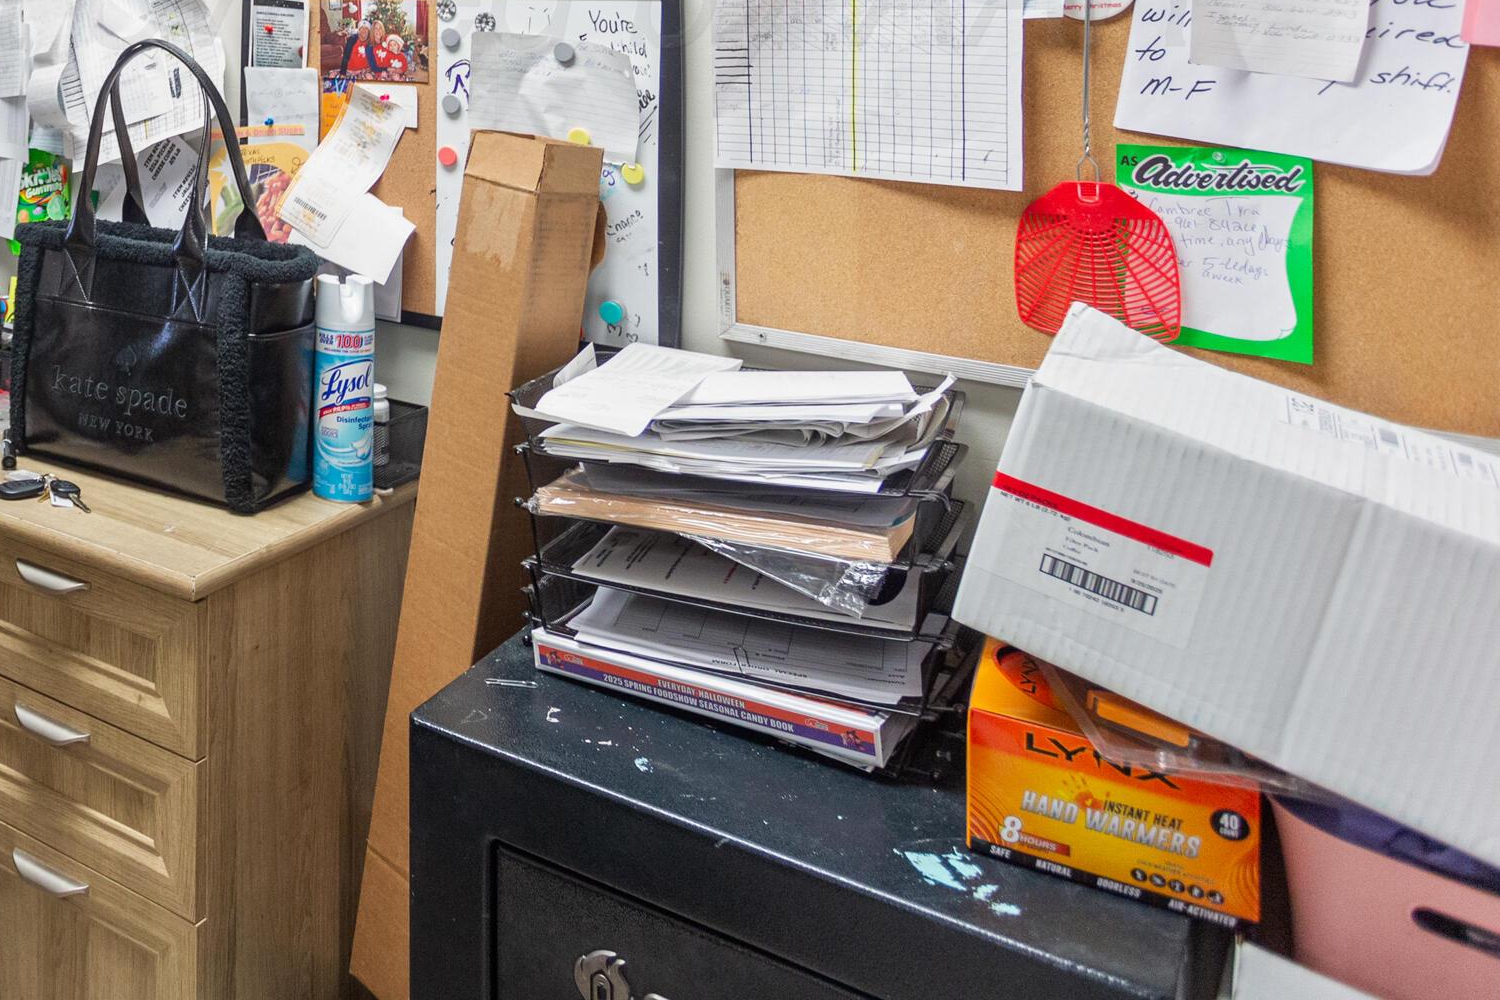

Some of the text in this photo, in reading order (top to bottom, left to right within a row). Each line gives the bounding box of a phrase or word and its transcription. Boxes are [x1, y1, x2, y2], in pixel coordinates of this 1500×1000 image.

[589, 10, 638, 34] You're
[1136, 36, 1166, 61] to
[1121, 155, 1137, 166] AS
[52, 364, 187, 418] kate spade
[322, 366, 372, 406] Lysol
[79, 413, 154, 441] NEW YORK
[604, 674, 794, 732] 2025 SPRING FOODSHOW SEASONAL CANDY BOOK
[1020, 790, 1202, 858] HAND WARMERS
[1104, 799, 1182, 830] INSTANT HEAT
[1220, 812, 1239, 829] 40
[1000, 816, 1056, 852] 8 HOURS
[990, 846, 1237, 926] SAFE NATURAL ODORLESS AIR-ACTIVATED
